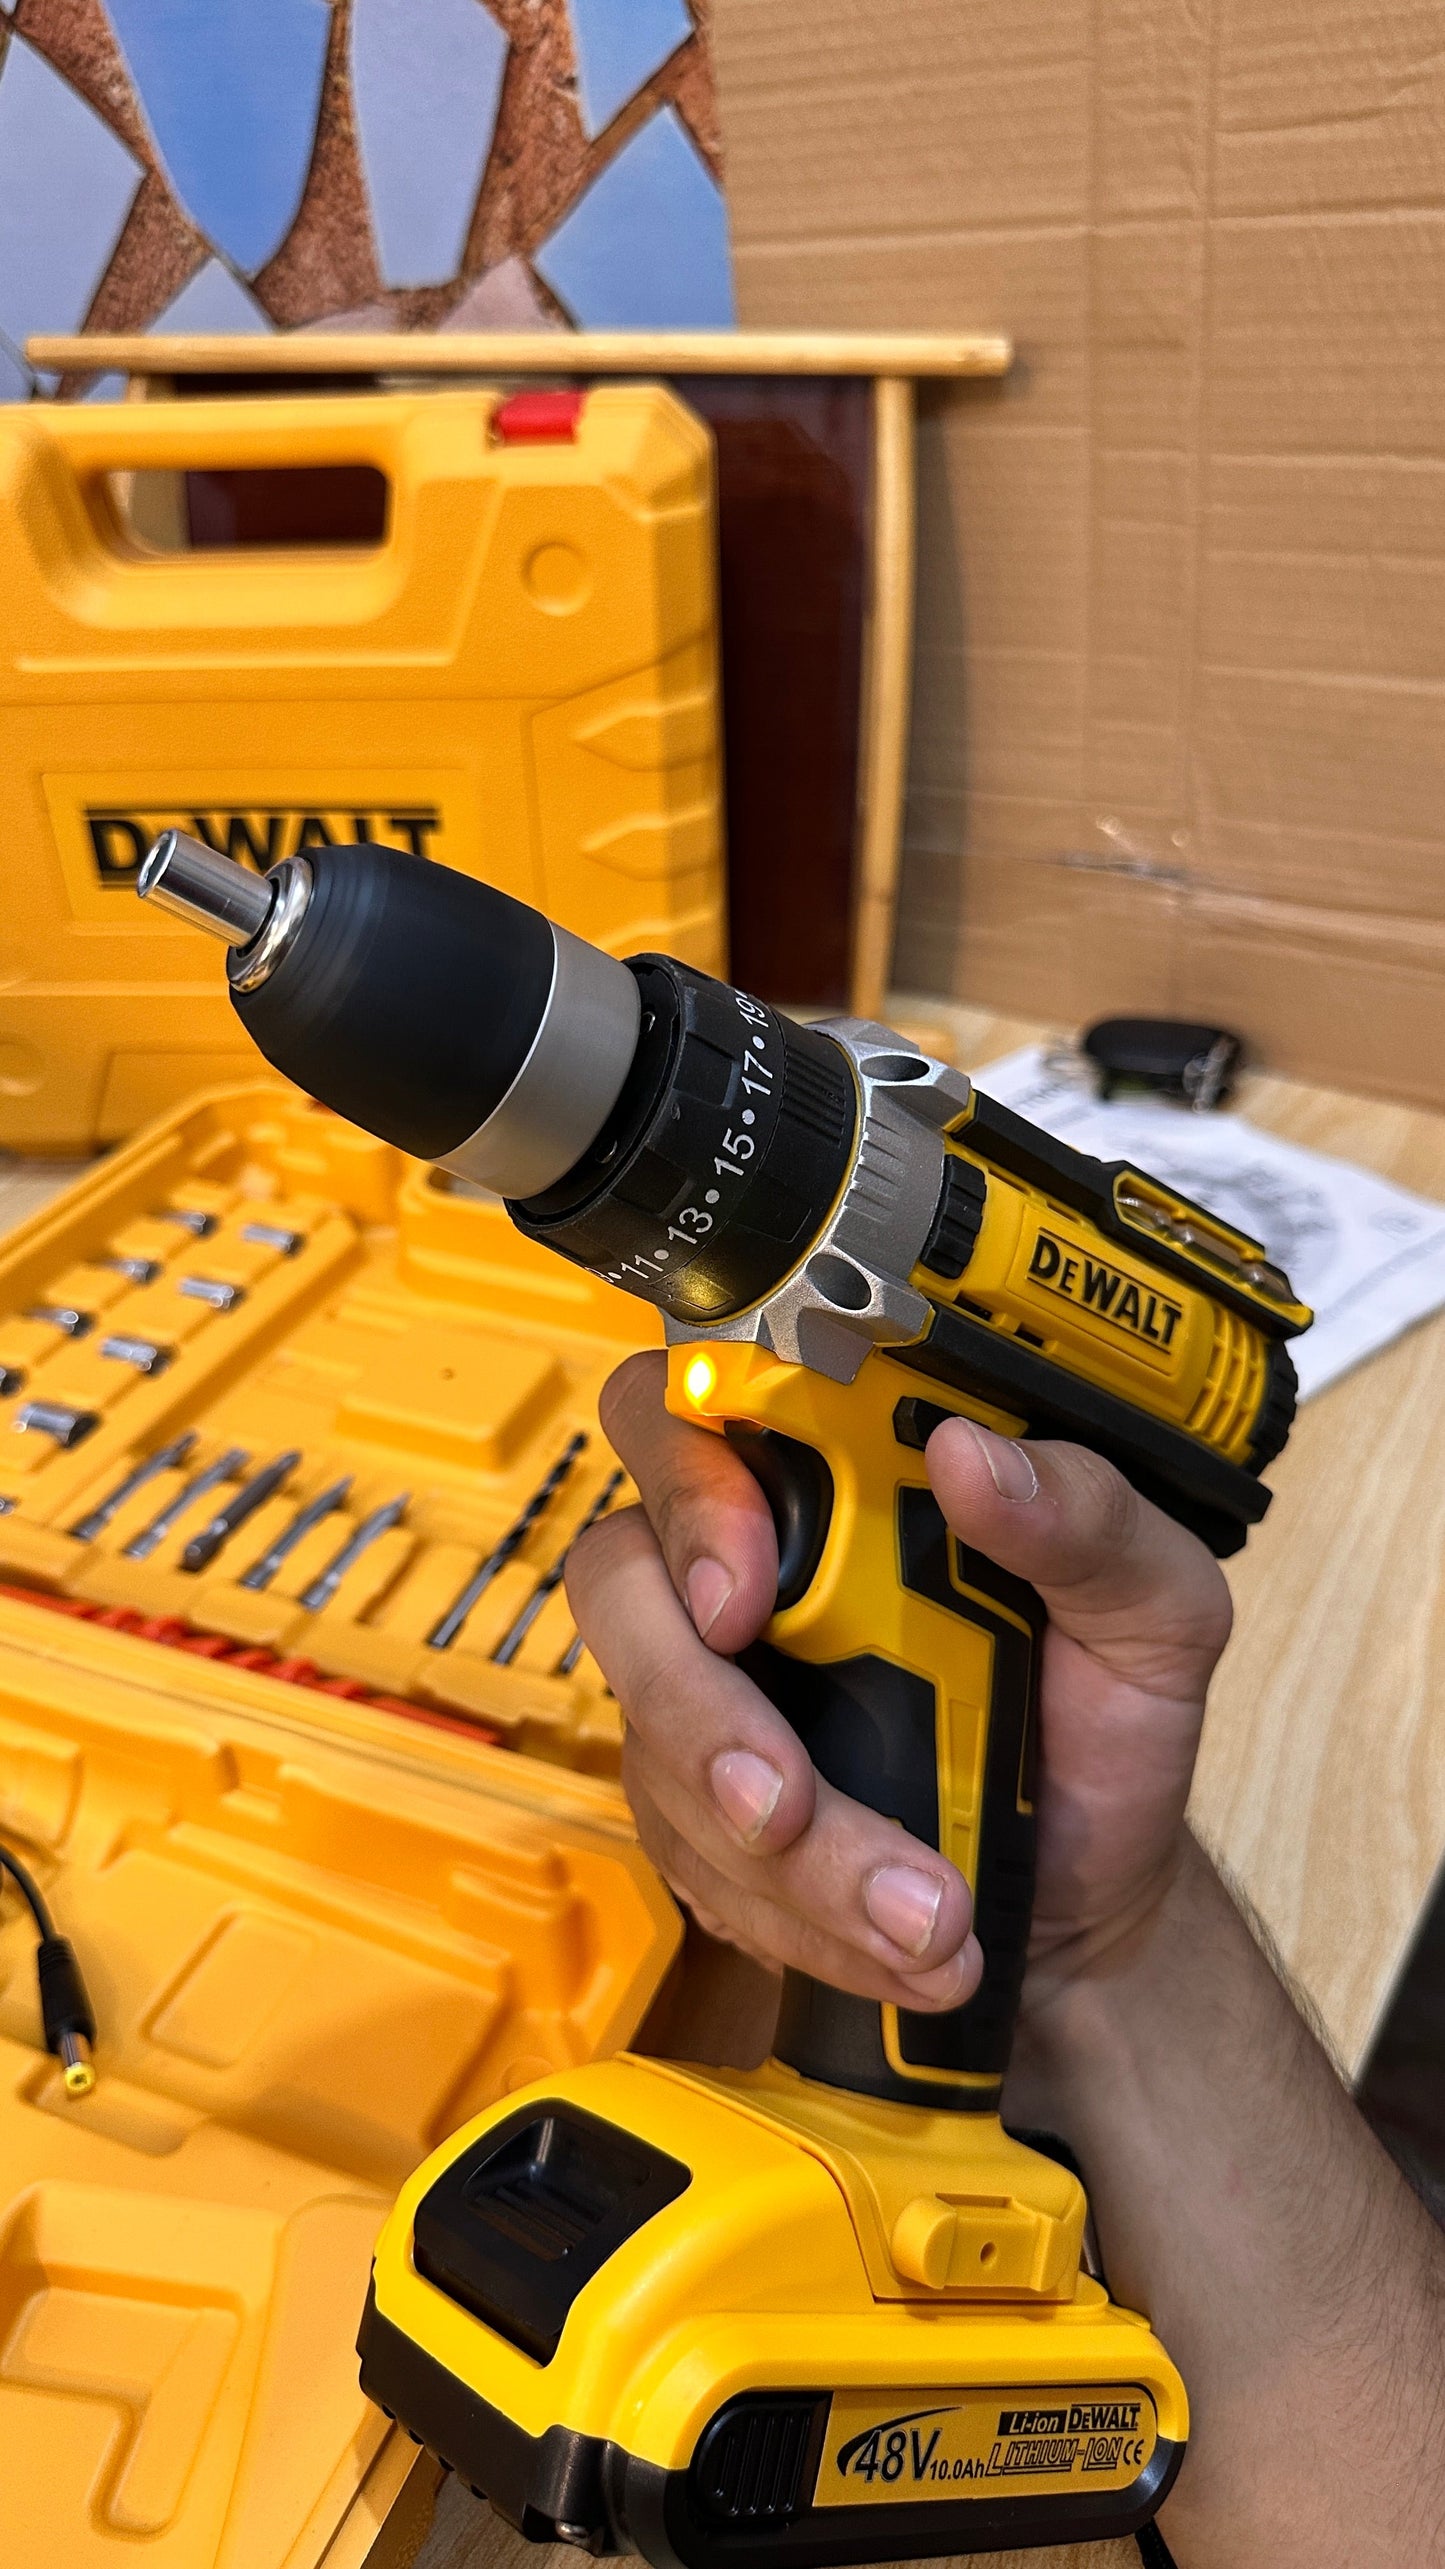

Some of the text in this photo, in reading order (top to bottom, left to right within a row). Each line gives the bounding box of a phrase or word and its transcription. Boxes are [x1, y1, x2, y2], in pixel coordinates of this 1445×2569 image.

[621, 998, 773, 1279] 11 13 15 17 19
[1008, 2412, 1059, 2434] Li-ion
[853, 2428, 943, 2483] 48V
[930, 2459, 985, 2481] 10.0Ah
[985, 2436, 1123, 2477] LITHIUM-ION
